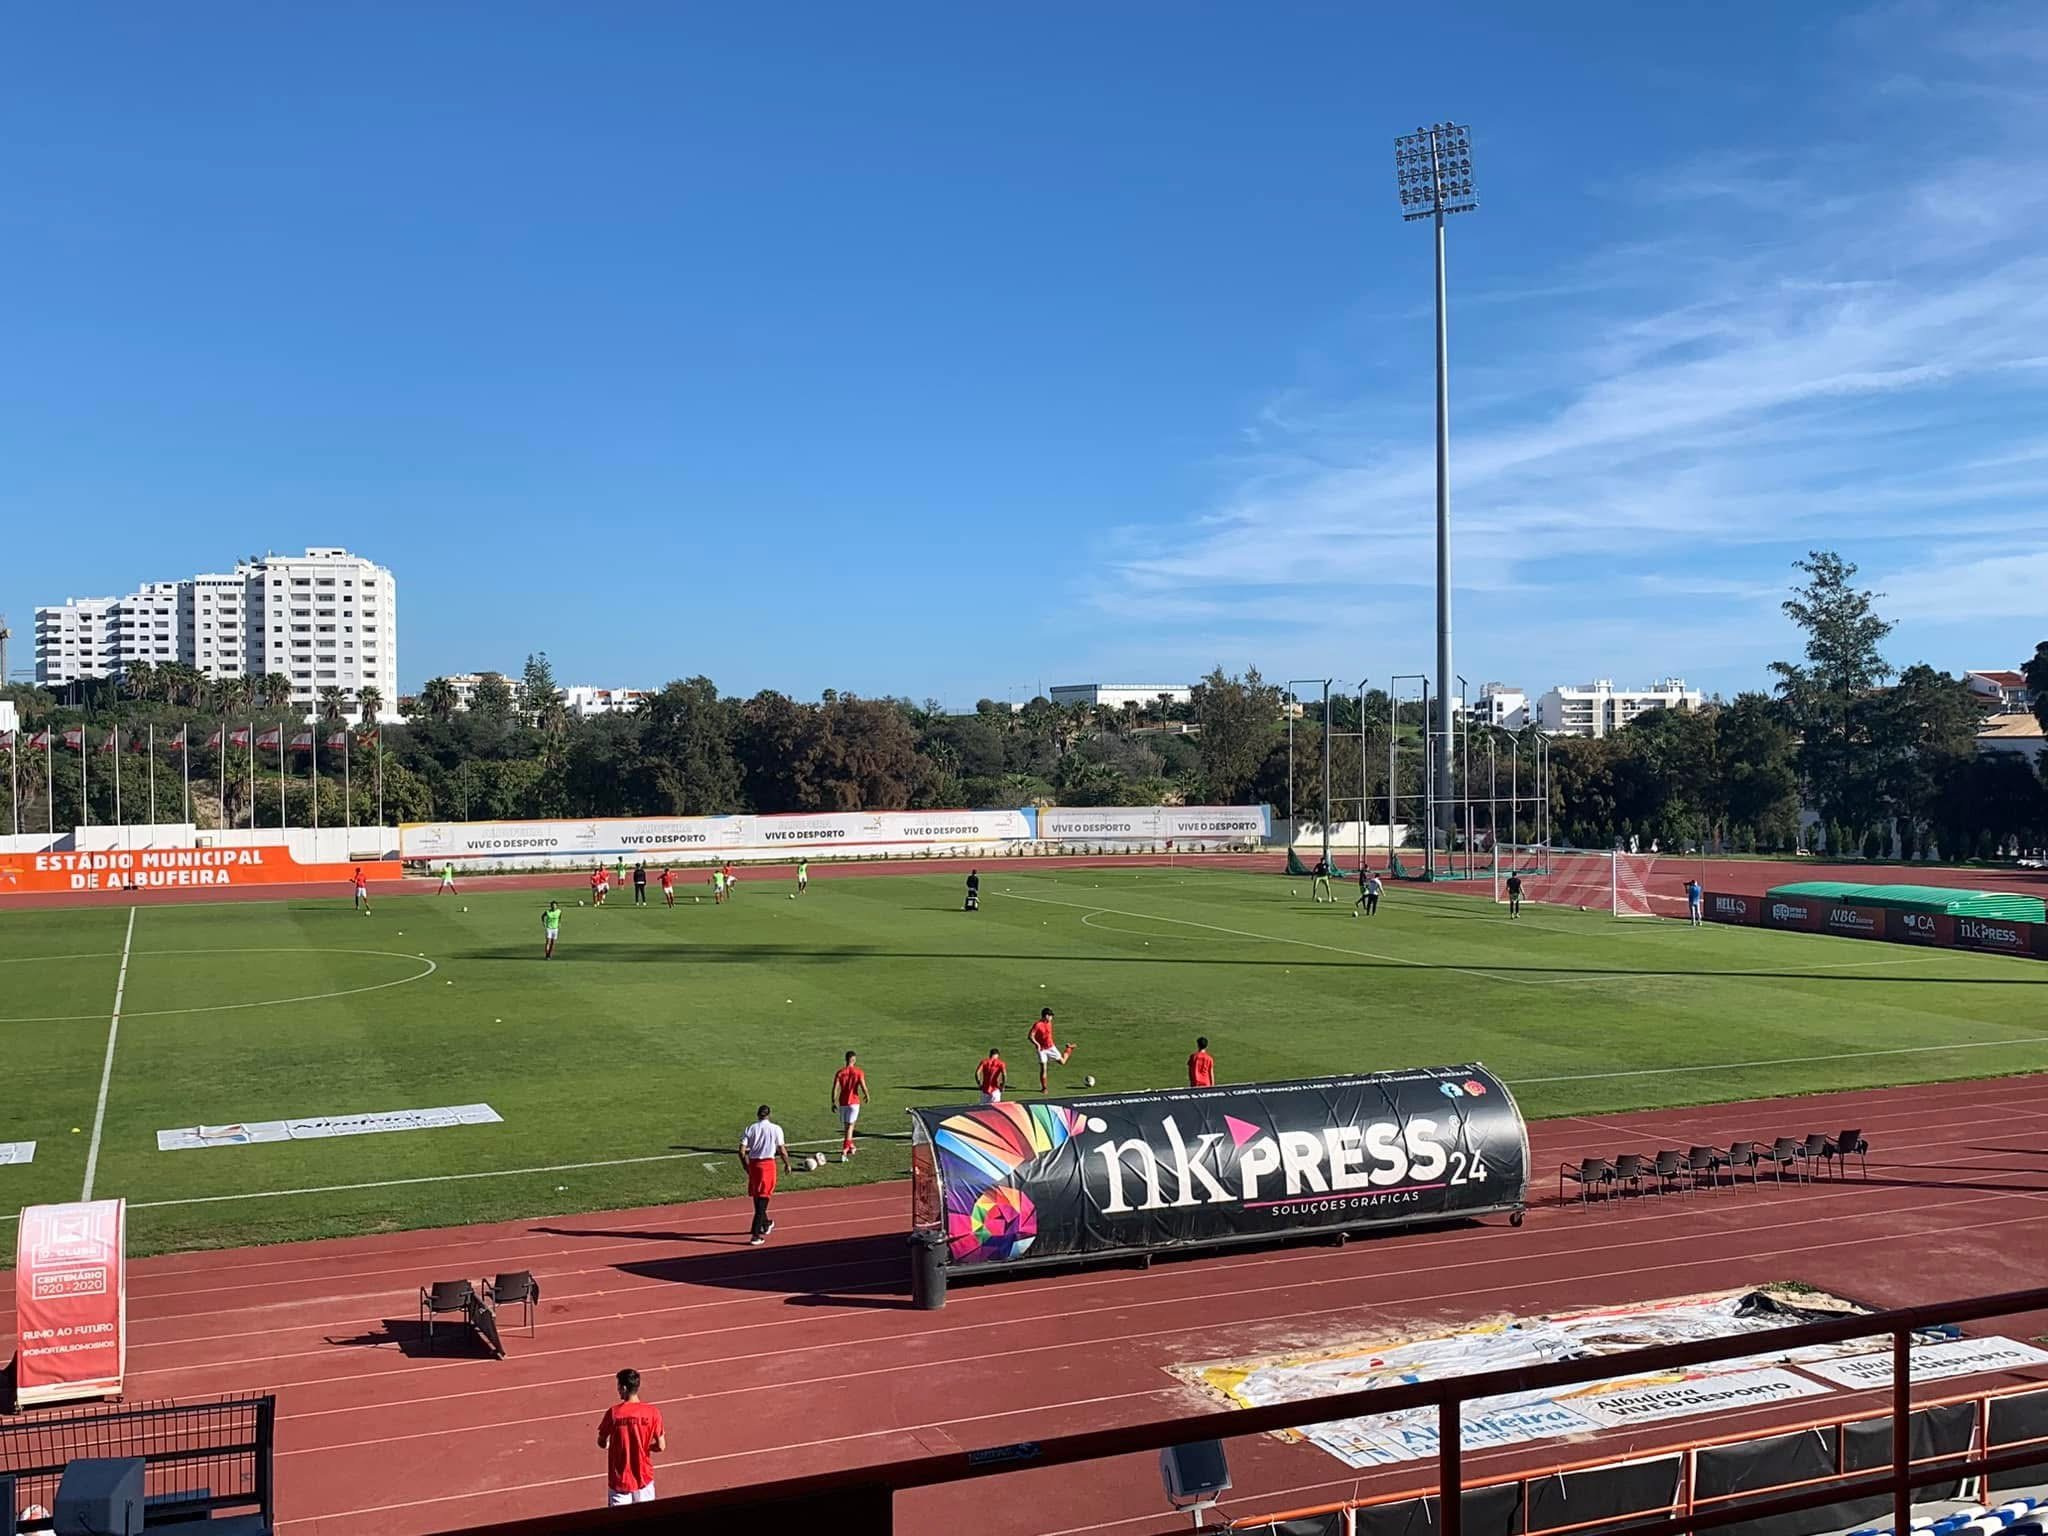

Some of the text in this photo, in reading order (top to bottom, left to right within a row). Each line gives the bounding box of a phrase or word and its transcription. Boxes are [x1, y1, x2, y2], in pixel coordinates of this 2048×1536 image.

[903, 826, 979, 836] VIVE O DESPORTO
[1051, 823, 1131, 833] VIVE O DESPORTO
[1177, 821, 1257, 831] VIVE O DESPORTO
[621, 834, 707, 844] VIVE O DESPORTO
[765, 829, 846, 840] VIVE O DESPORTO
[467, 838, 558, 849] VIVE O DESPORTO
[35, 849, 264, 872] ESTÁDIO MUNICIPAL
[70, 868, 231, 889] DE ALBUFEIRA
[1830, 909, 1857, 923] NBG
[1918, 916, 1936, 930] CA
[1448, 1150, 1488, 1186] 24
[1272, 1190, 1420, 1217] SOLUÇÕES GRÁFICAS
[37, 1271, 103, 1285] CENTENÁRIO
[38, 1283, 64, 1295] 1920
[73, 1279, 103, 1291] 2020
[23, 1323, 114, 1340] RUMO AO FUTURO
[1598, 1389, 1699, 1410] Albufeira
[1608, 1402, 1665, 1416] VIVE
[1682, 1382, 1791, 1405] DESPORTO
[1402, 1411, 1571, 1443] Alufeira
